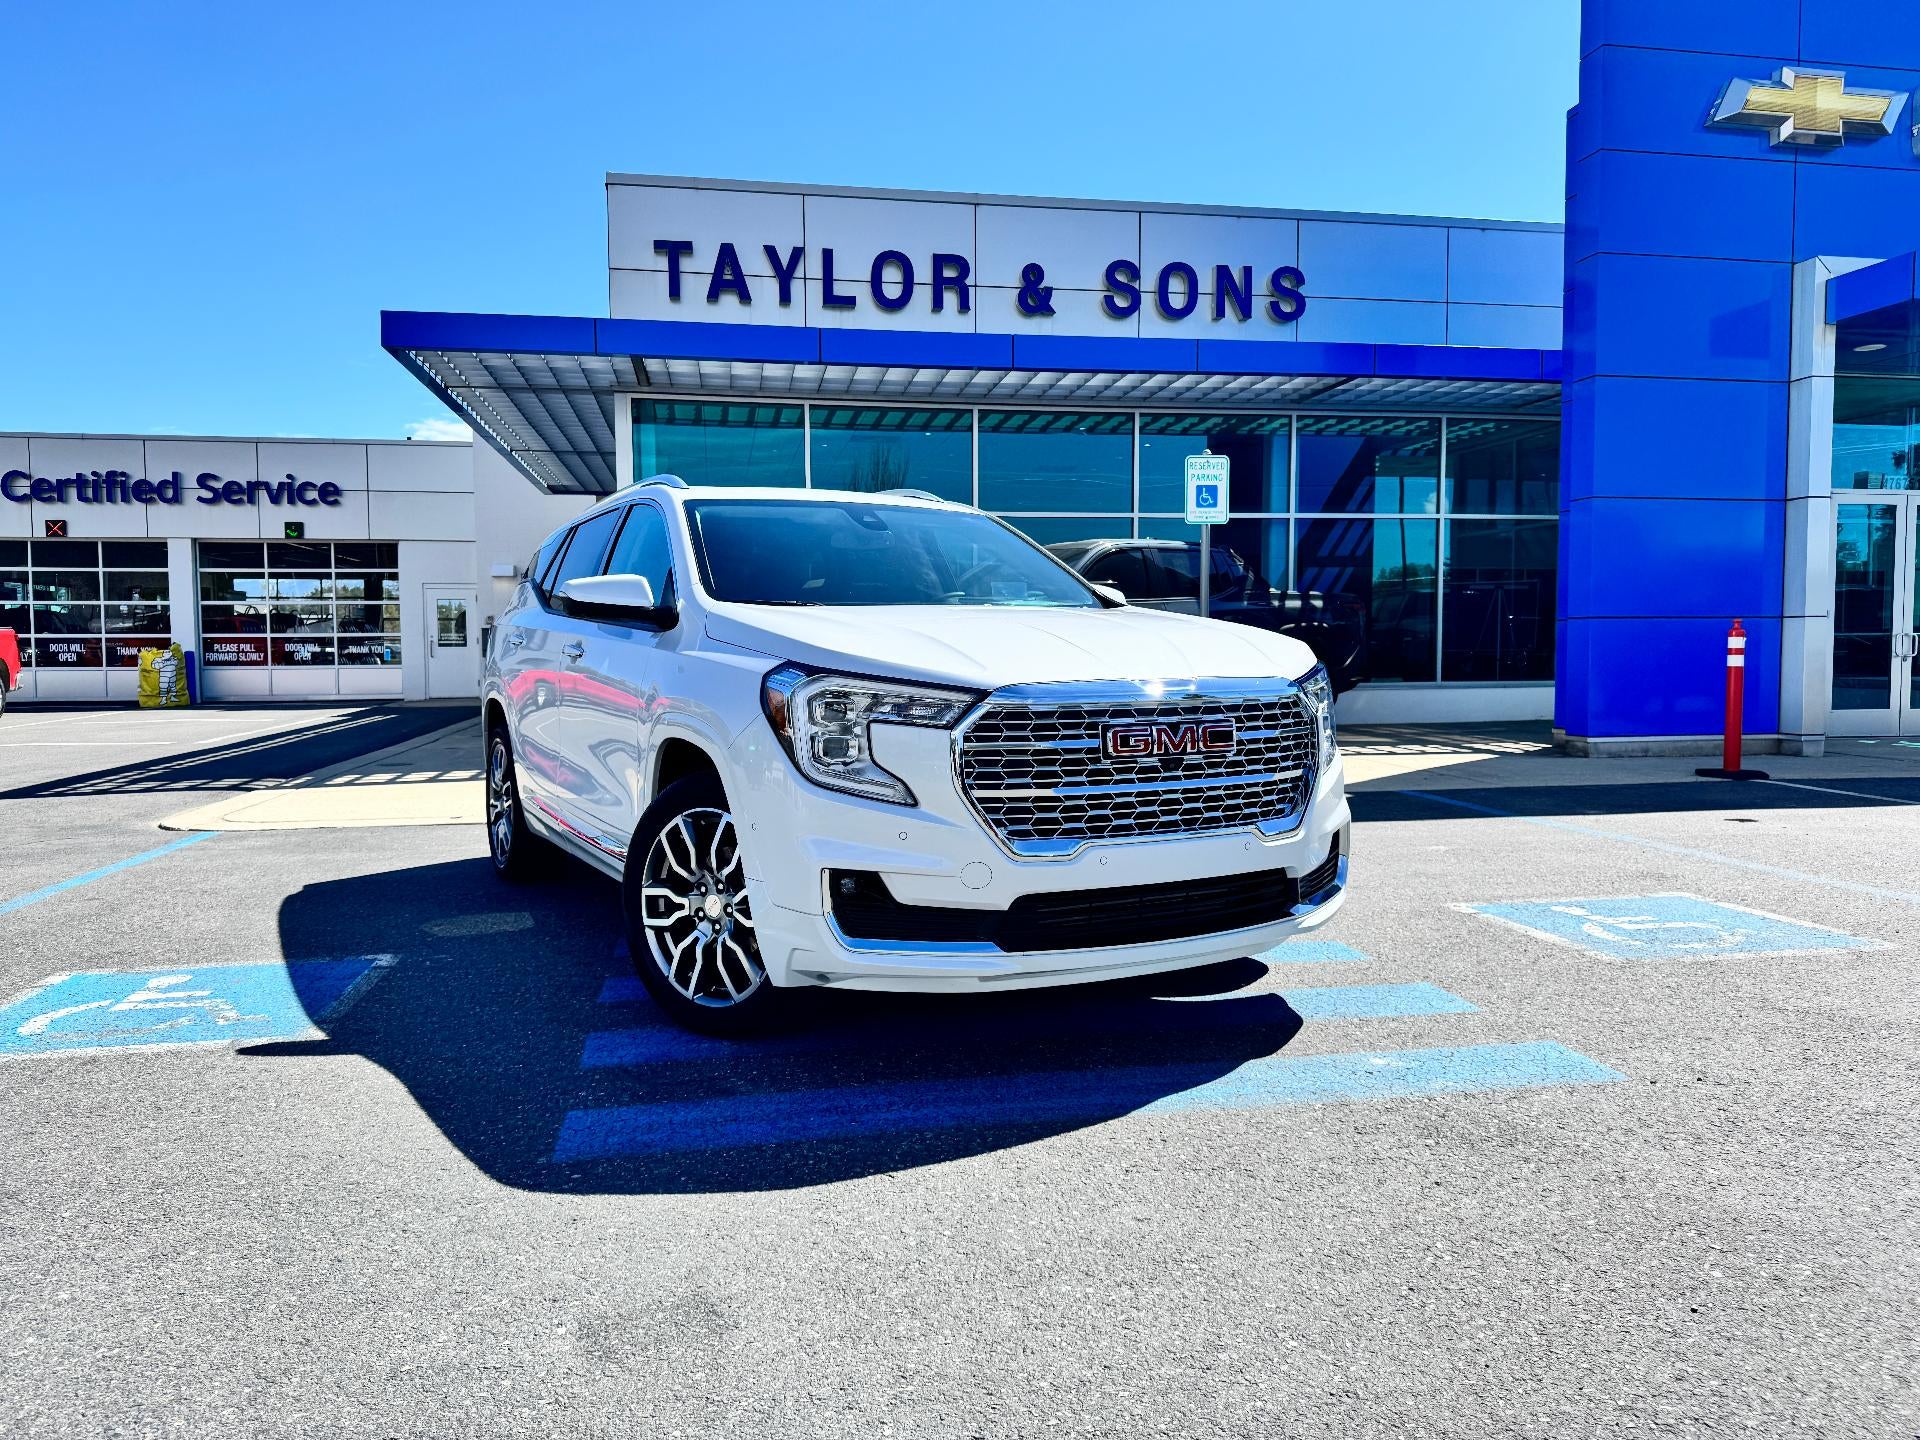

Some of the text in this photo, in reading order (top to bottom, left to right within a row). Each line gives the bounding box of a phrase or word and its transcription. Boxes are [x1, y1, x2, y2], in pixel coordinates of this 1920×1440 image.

[652, 239, 1307, 323] TAYLOR & SONS
[1189, 461, 1226, 470] RESERVED
[1191, 473, 1224, 482] PARKING
[0, 469, 342, 506] Certified Service
[49, 643, 86, 652] DOOR WILL
[116, 646, 139, 656] THANK
[213, 643, 256, 652] PLEASE PULL
[349, 645, 384, 654] THANK YOU
[58, 652, 77, 662] OPEN
[205, 652, 265, 661] FORWARD SLOWLY
[1108, 722, 1236, 757] GMC
